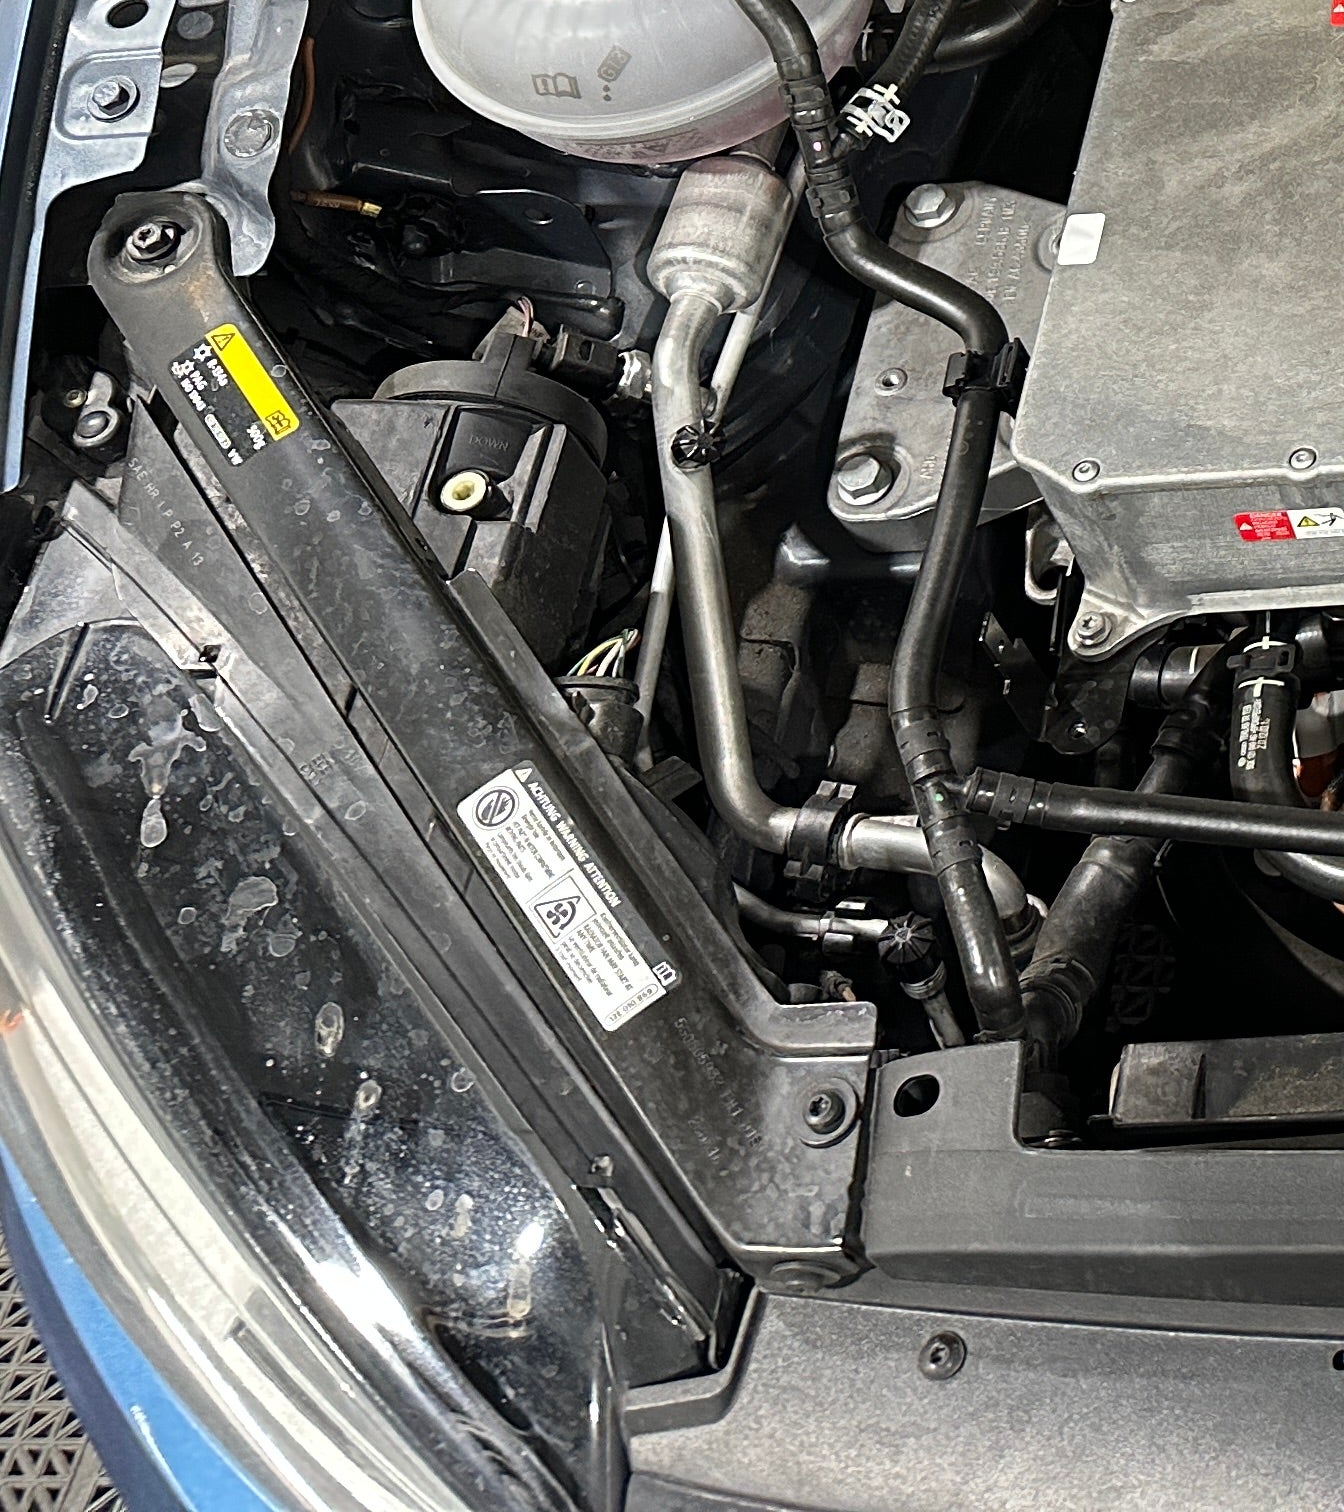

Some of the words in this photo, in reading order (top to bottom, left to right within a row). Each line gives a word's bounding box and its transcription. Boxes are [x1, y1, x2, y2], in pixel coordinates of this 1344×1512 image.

[189, 369, 208, 391] PAG
[469, 434, 508, 452] DOWN
[128, 457, 148, 481] SAE
[528, 782, 561, 823] ACHTUNG
[557, 822, 589, 863] WARNING
[583, 859, 622, 908] ATTENTION
